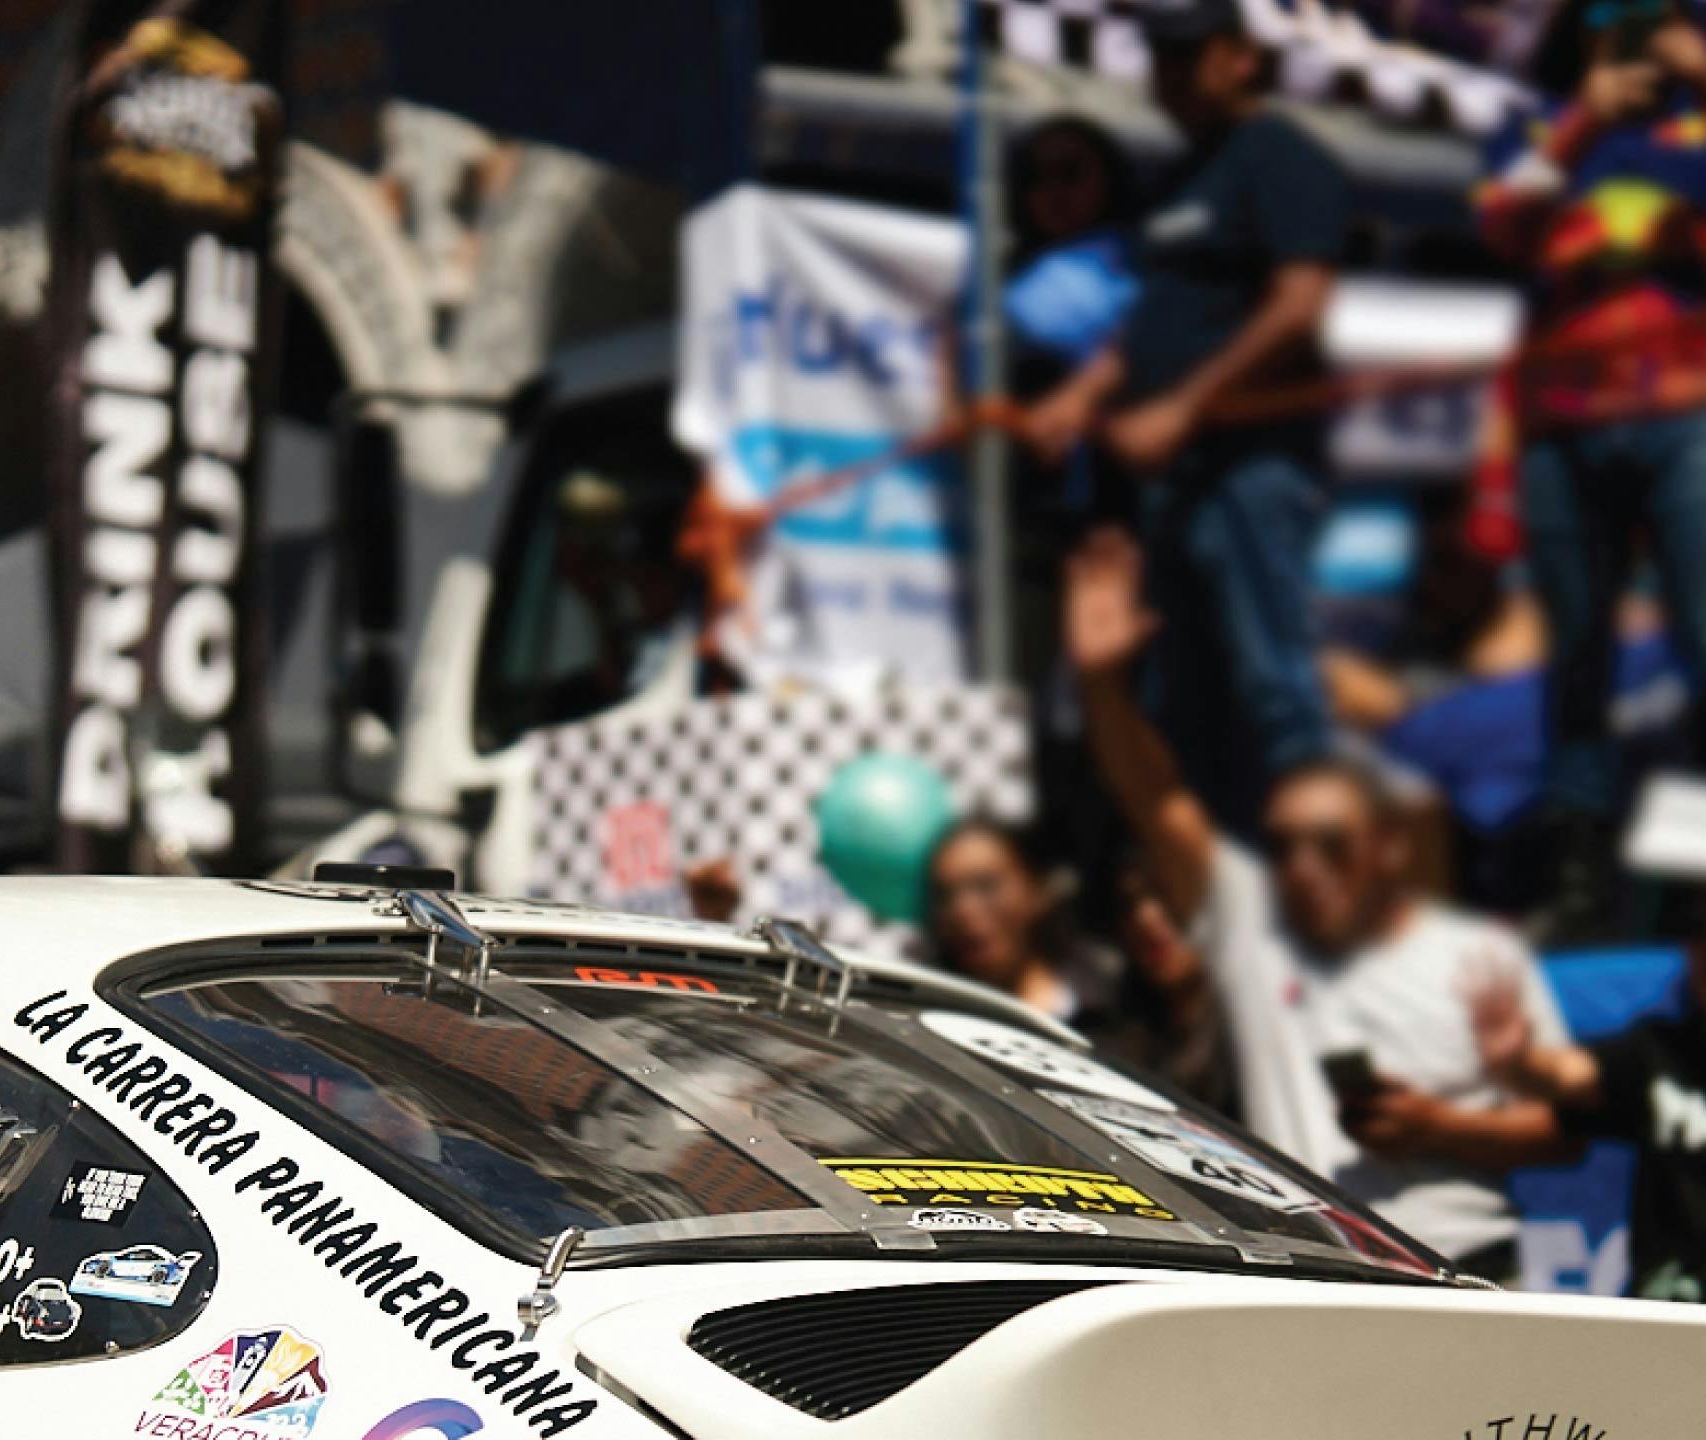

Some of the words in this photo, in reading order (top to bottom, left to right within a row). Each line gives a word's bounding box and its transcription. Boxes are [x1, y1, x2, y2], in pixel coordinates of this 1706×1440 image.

[59, 252, 175, 828] DRINK
[13, 990, 90, 1044] LA
[66, 1026, 260, 1176] CARRERA
[235, 1155, 598, 1440] PANAMERICANA
[870, 1193, 1176, 1220] RACING
